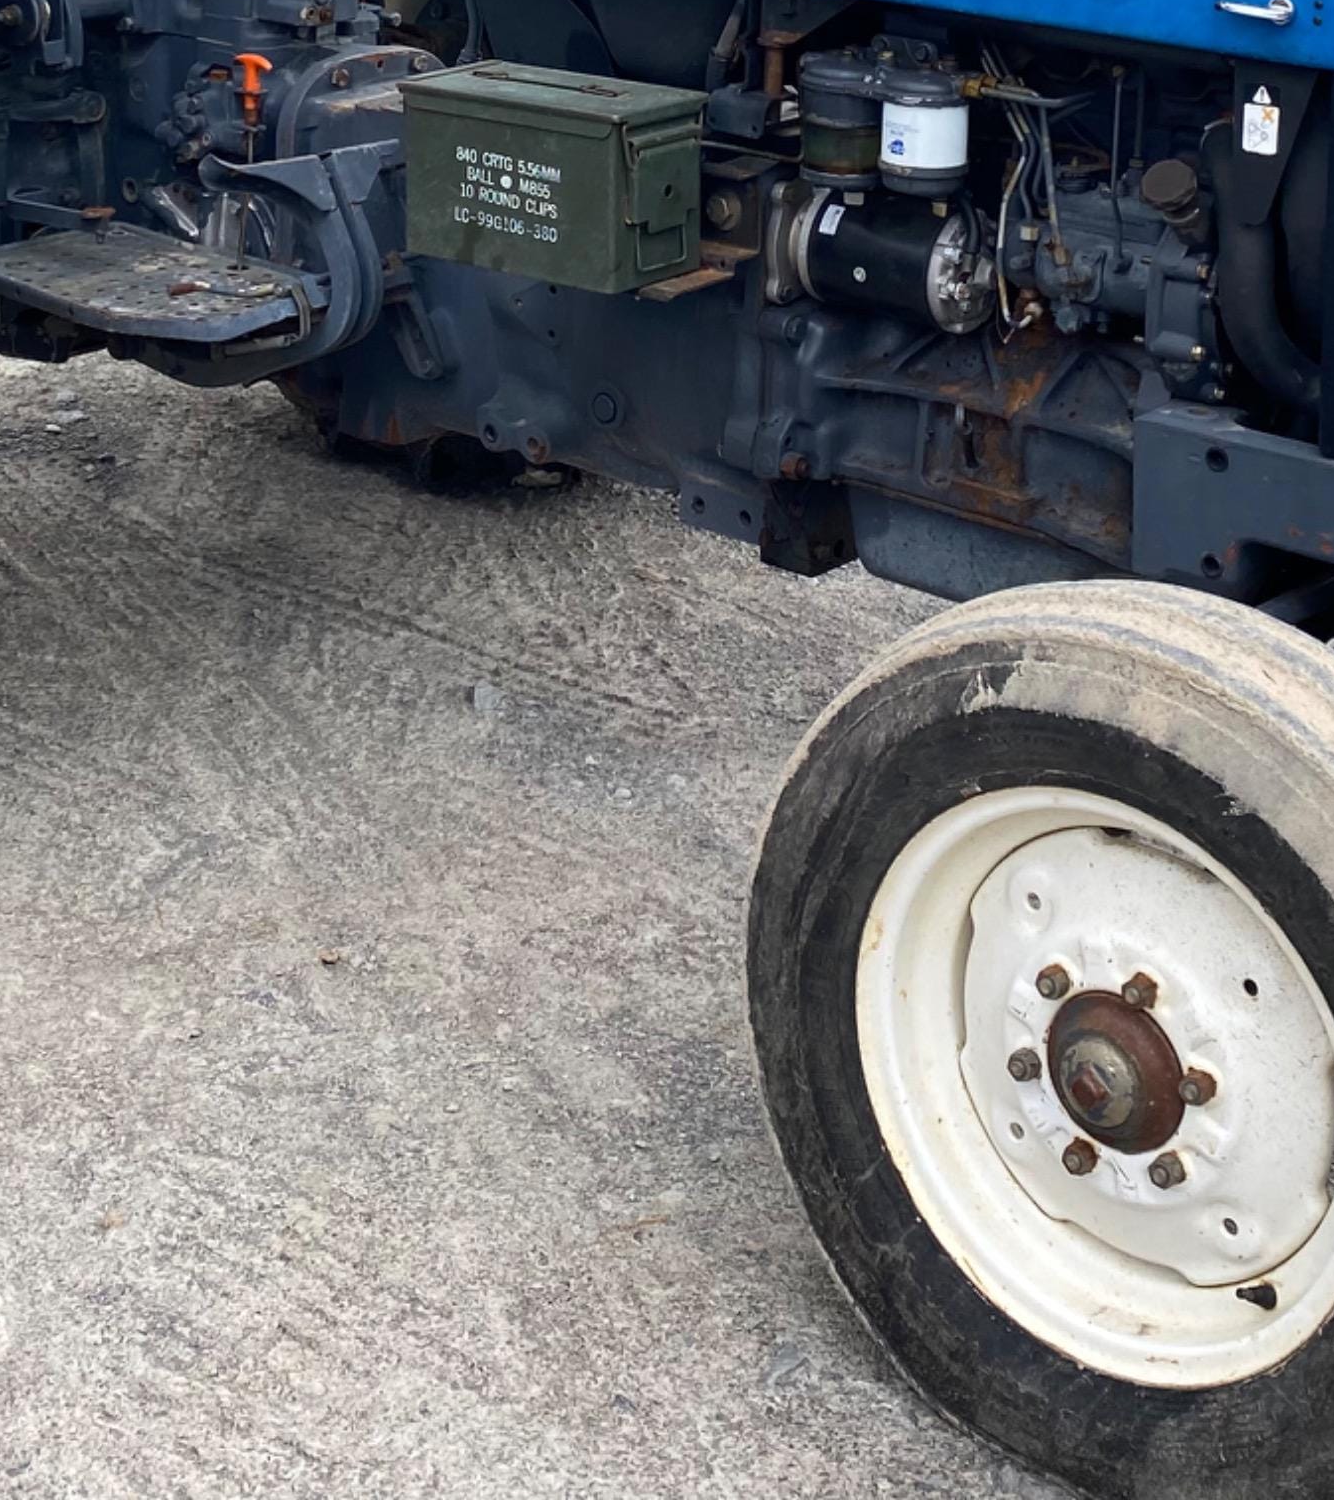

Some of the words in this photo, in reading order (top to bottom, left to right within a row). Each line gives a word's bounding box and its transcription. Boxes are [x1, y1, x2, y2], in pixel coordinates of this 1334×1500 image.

[455, 146, 477, 164] 840
[482, 152, 513, 172] CRTG
[517, 160, 561, 183] 5.56MM
[467, 166, 495, 185] BALL
[519, 178, 551, 199] M855
[460, 182, 474, 198] 10
[478, 186, 521, 209] ROUND
[525, 198, 558, 219] CLIPS
